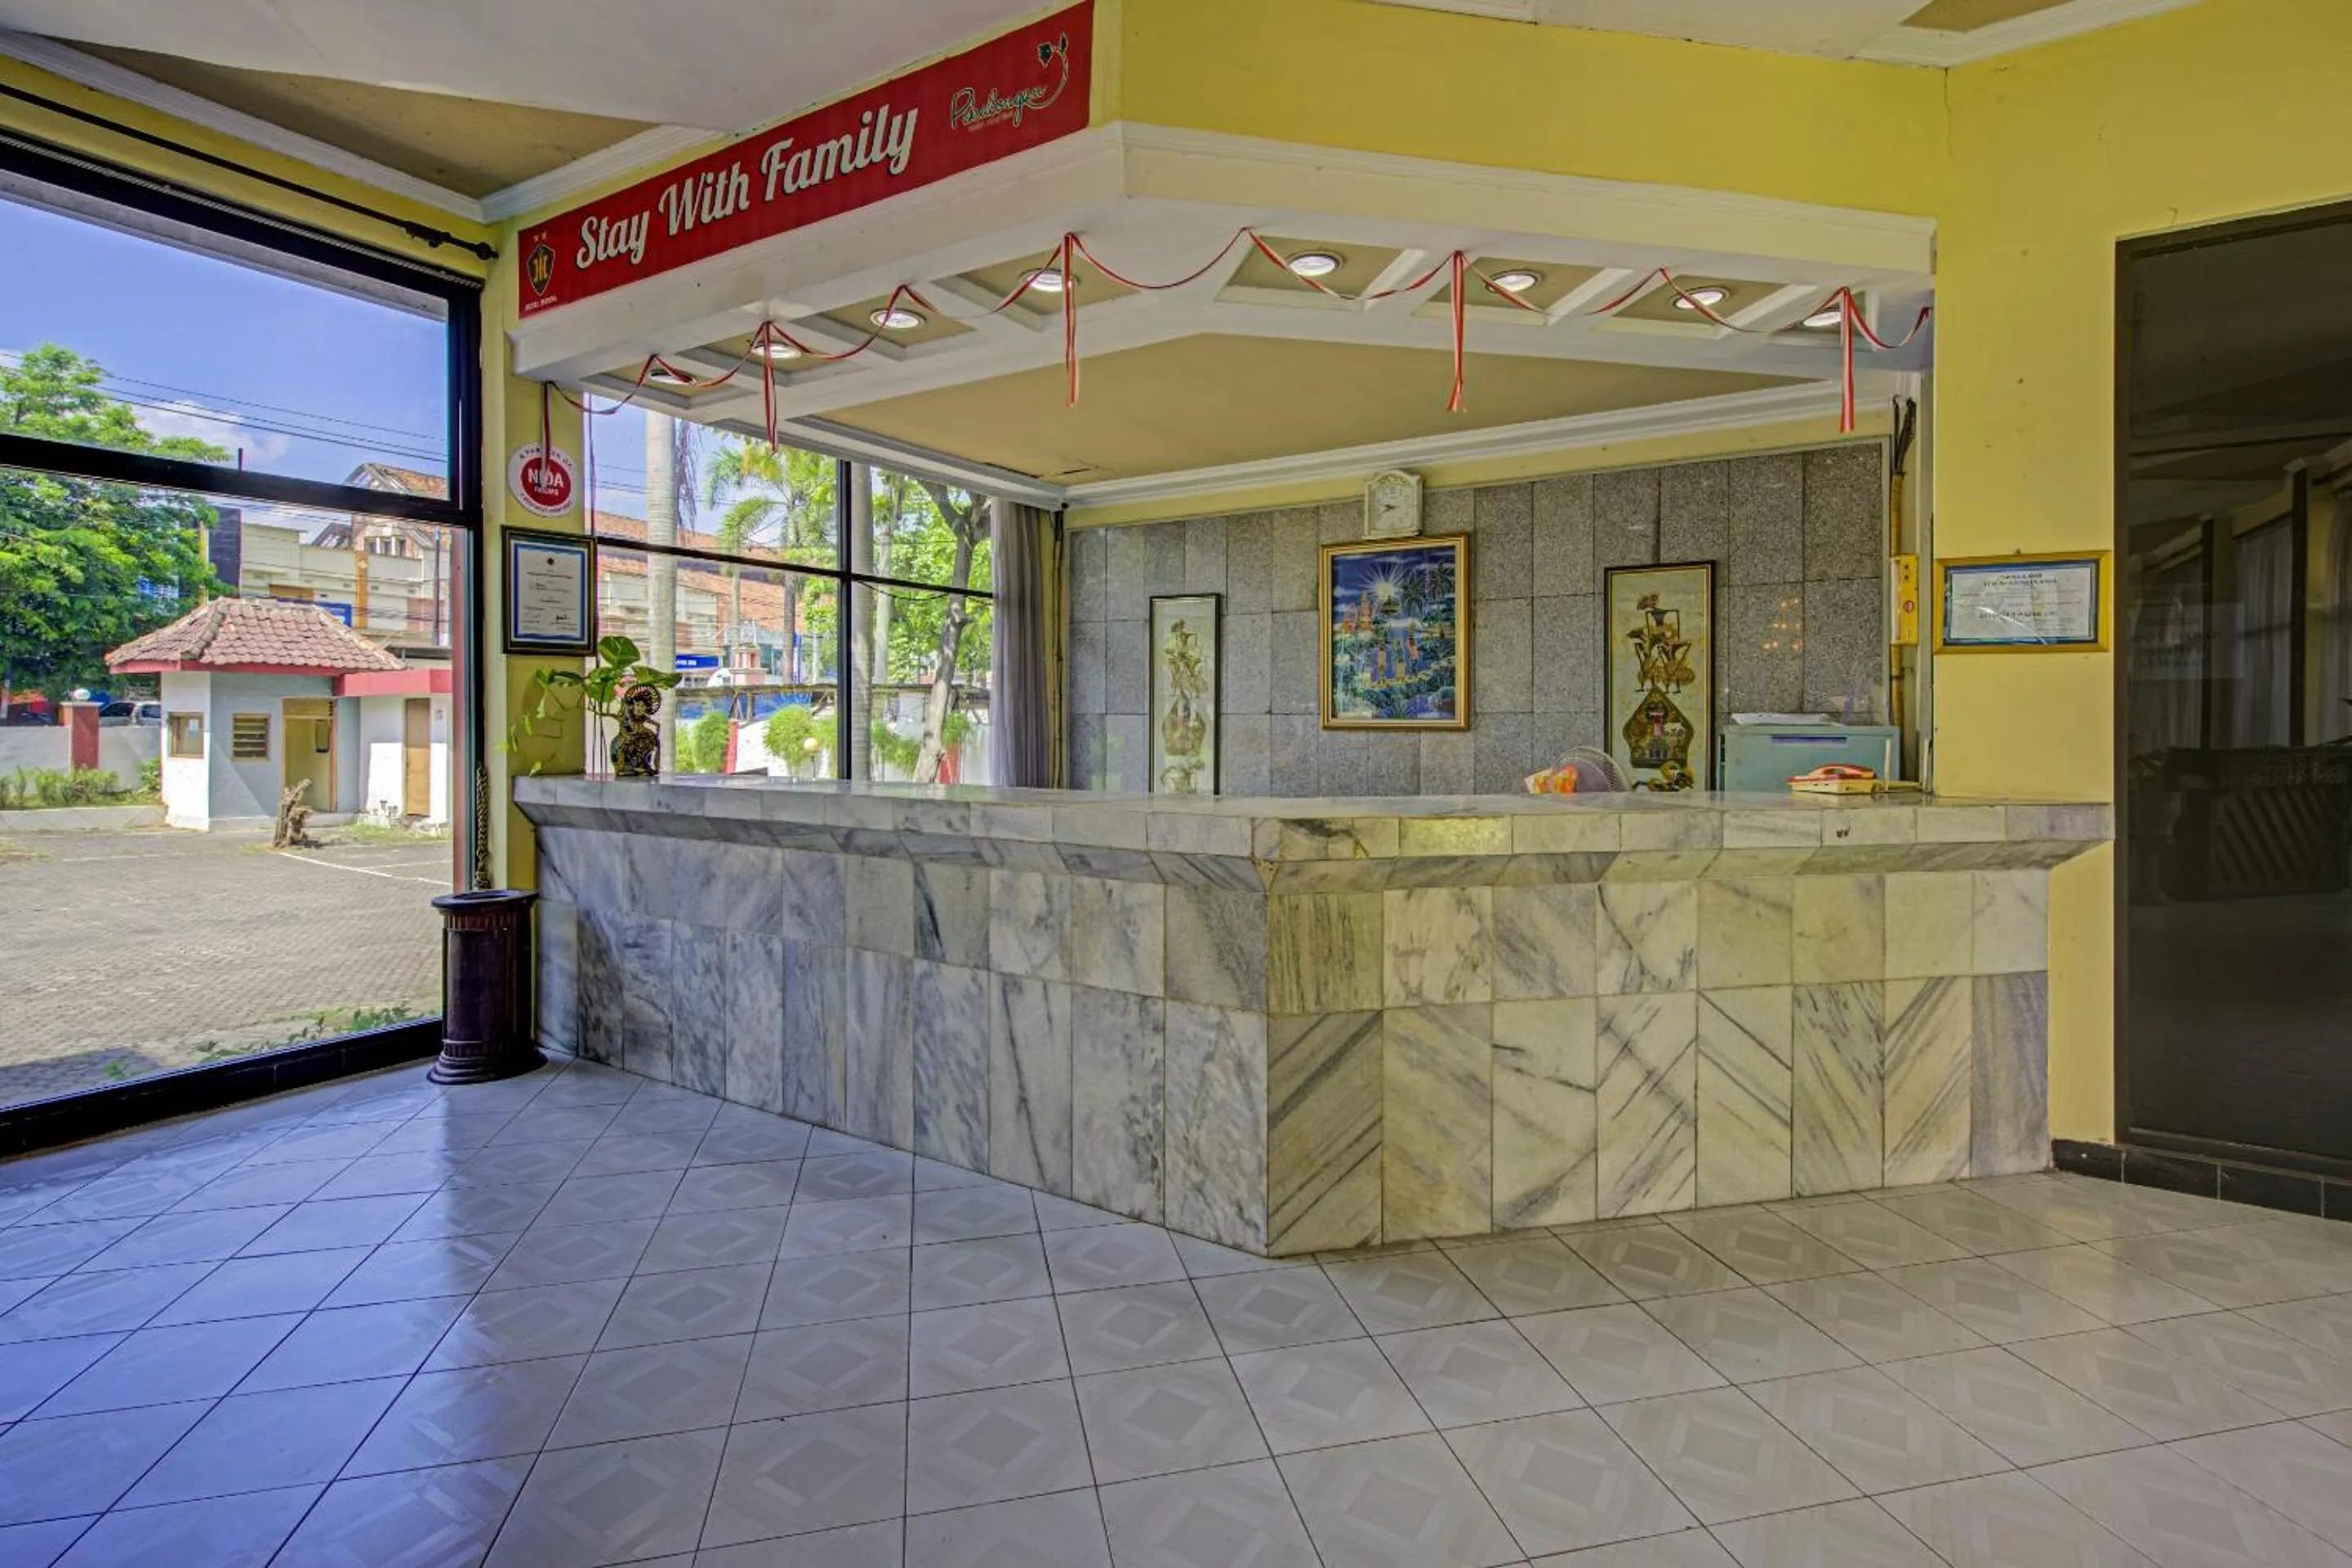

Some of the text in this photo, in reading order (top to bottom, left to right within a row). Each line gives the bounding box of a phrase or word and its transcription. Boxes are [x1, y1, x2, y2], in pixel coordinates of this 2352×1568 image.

[576, 210, 650, 270] Stay
[658, 160, 751, 237] With
[760, 103, 919, 202] Family
